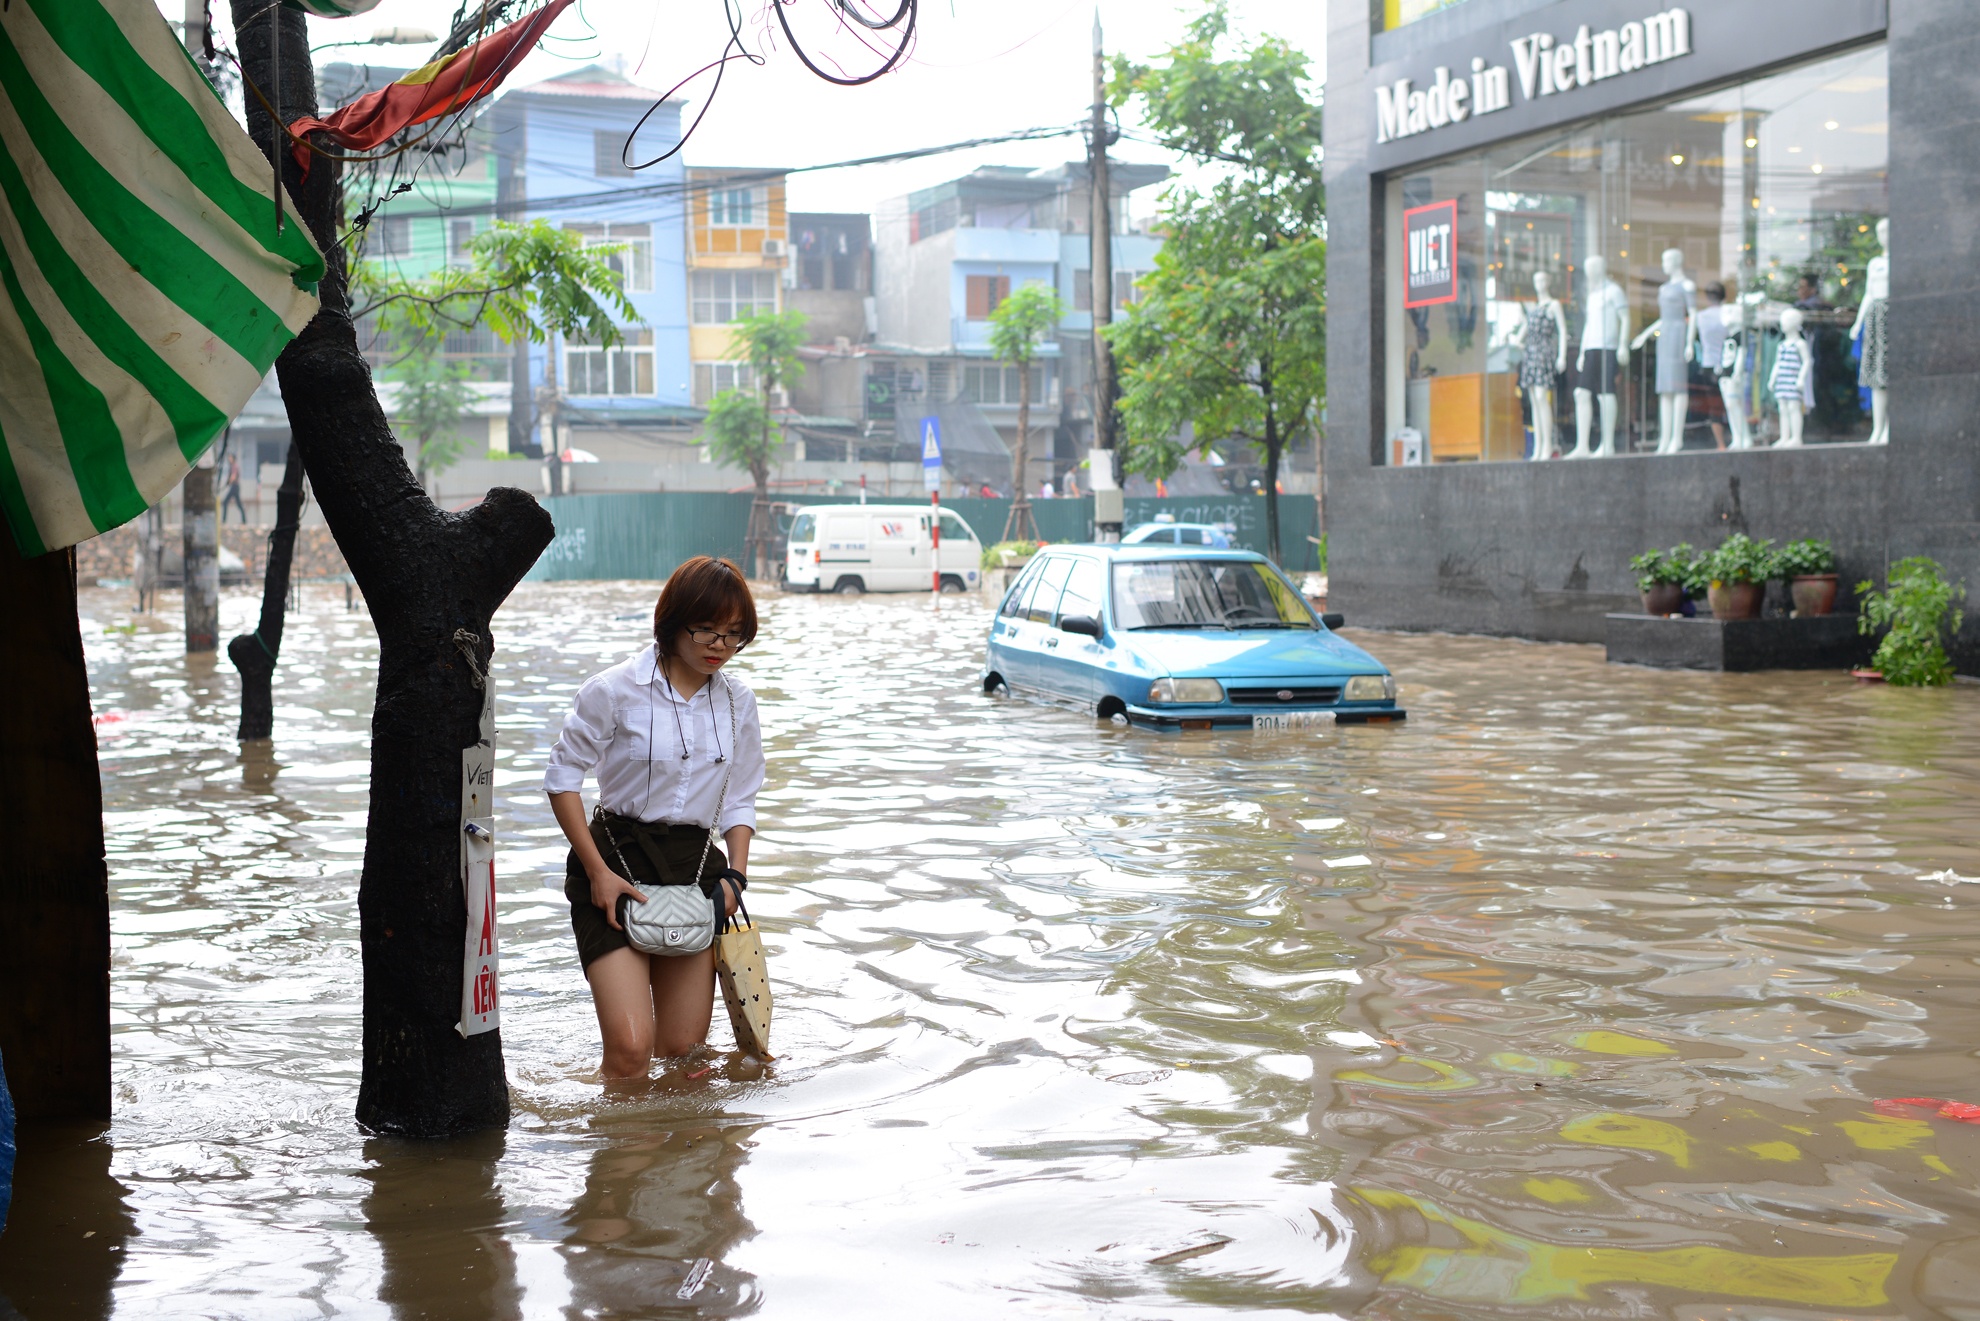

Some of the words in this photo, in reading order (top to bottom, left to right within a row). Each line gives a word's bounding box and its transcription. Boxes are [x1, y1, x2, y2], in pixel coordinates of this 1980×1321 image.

[1374, 66, 1469, 144] Made
[1471, 57, 1510, 116] in
[1509, 7, 1691, 100] Vietnam
[1409, 224, 1450, 274] VIET
